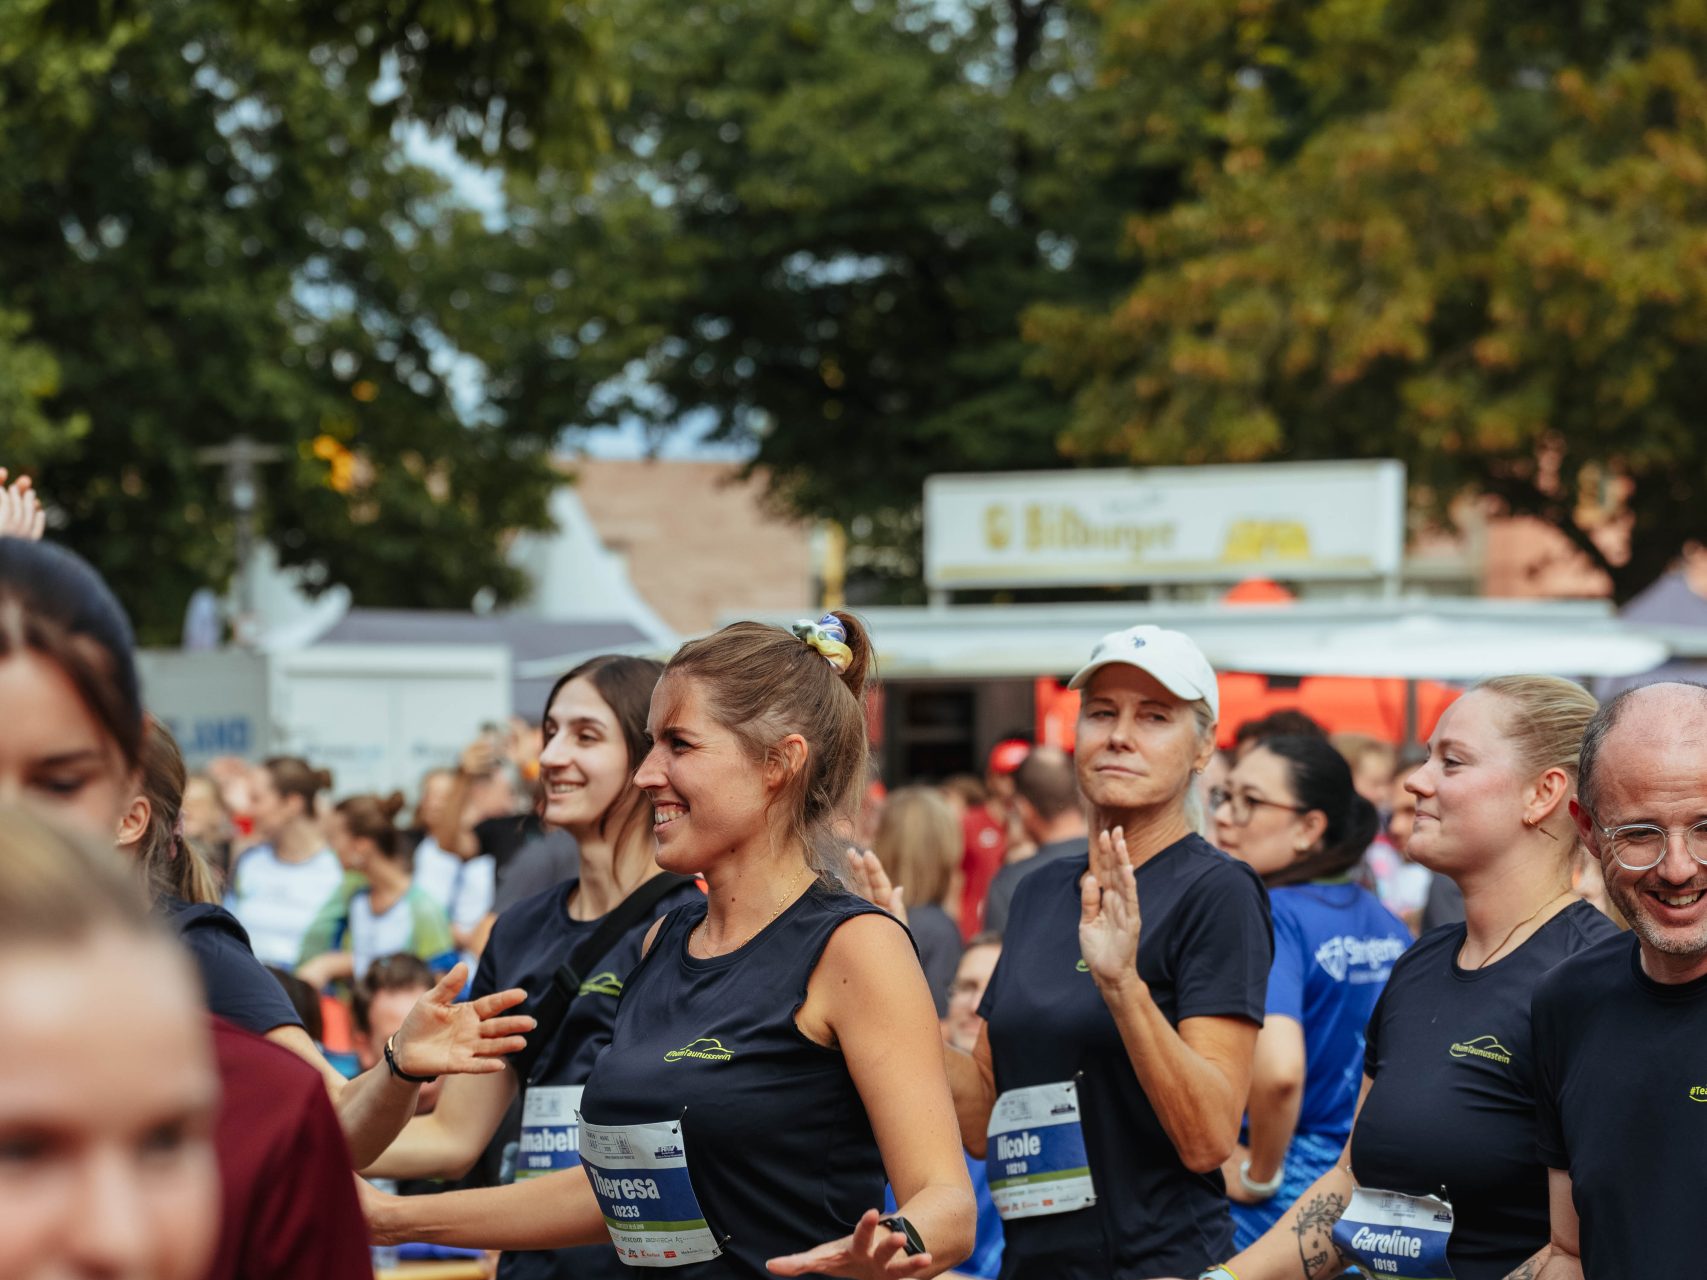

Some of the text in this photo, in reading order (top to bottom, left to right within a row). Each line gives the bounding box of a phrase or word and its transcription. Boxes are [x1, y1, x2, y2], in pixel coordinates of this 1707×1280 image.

[589, 1165, 661, 1200] Theresa
[612, 1204, 640, 1218] 10233
[1351, 1226, 1422, 1259] Caroline
[1372, 1257, 1398, 1273] 10193
